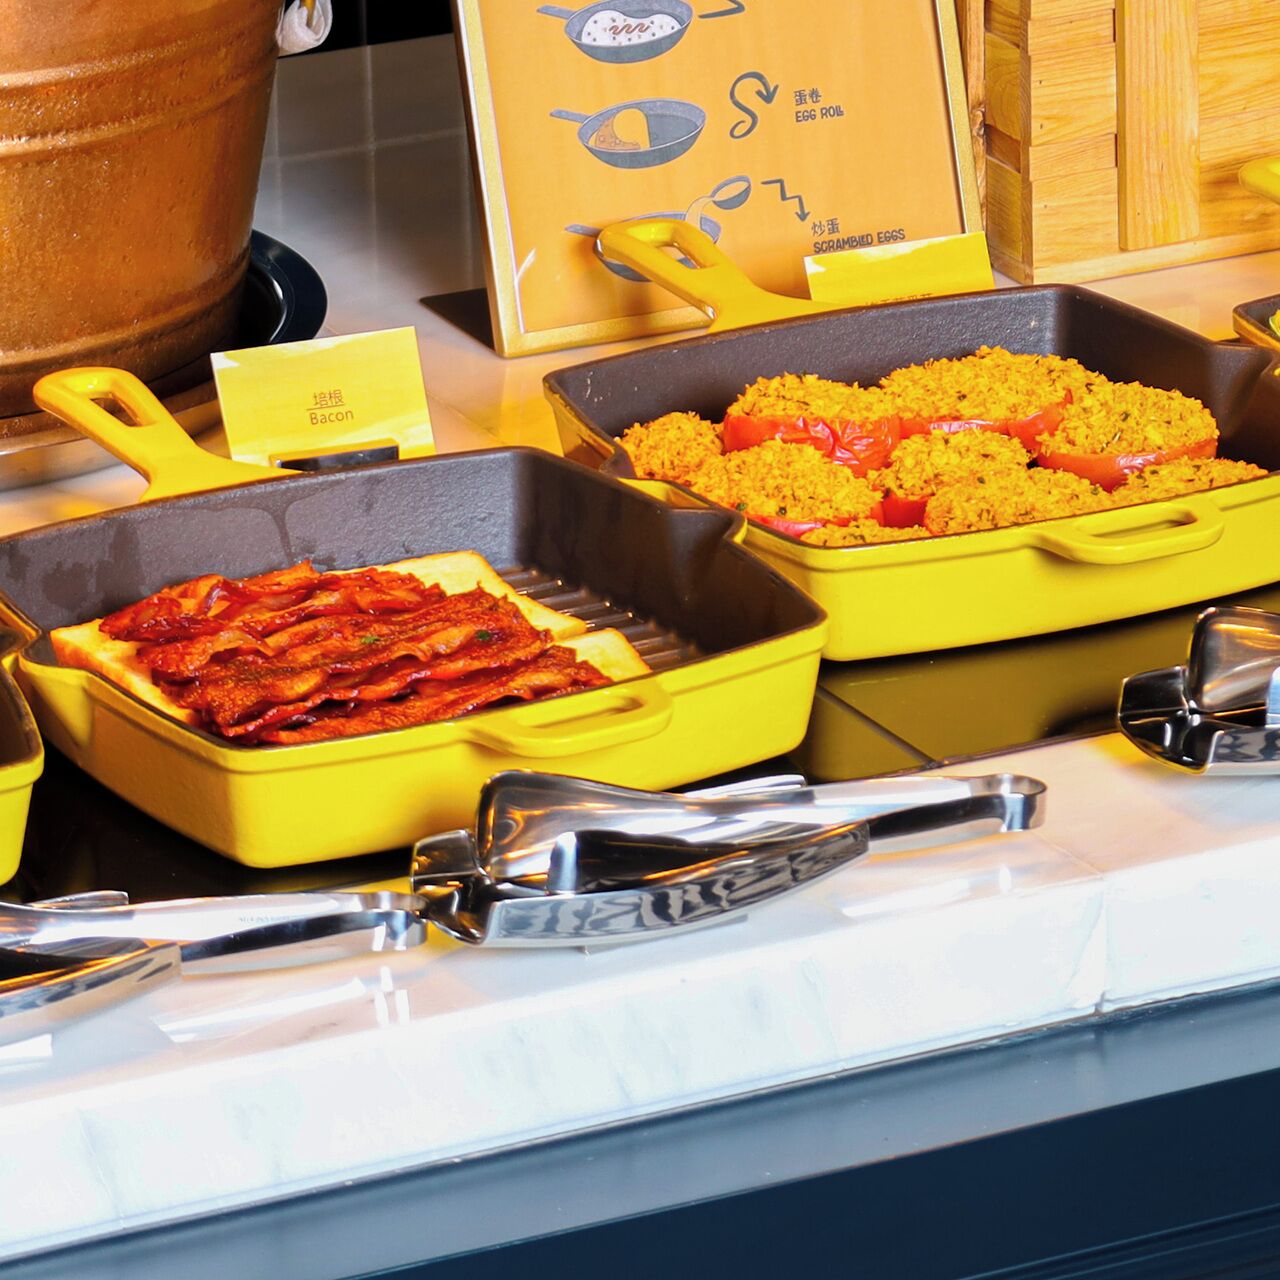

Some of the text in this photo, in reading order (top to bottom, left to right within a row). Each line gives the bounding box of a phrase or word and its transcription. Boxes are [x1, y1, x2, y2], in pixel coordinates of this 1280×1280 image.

[793, 87, 822, 107] 蛋卷
[795, 105, 845, 123] EGG ROLL
[811, 218, 841, 238] 炒蛋
[813, 228, 906, 254] SCRAMBLED EGGS
[313, 389, 345, 407] 培根
[309, 408, 354, 426] Bacon
